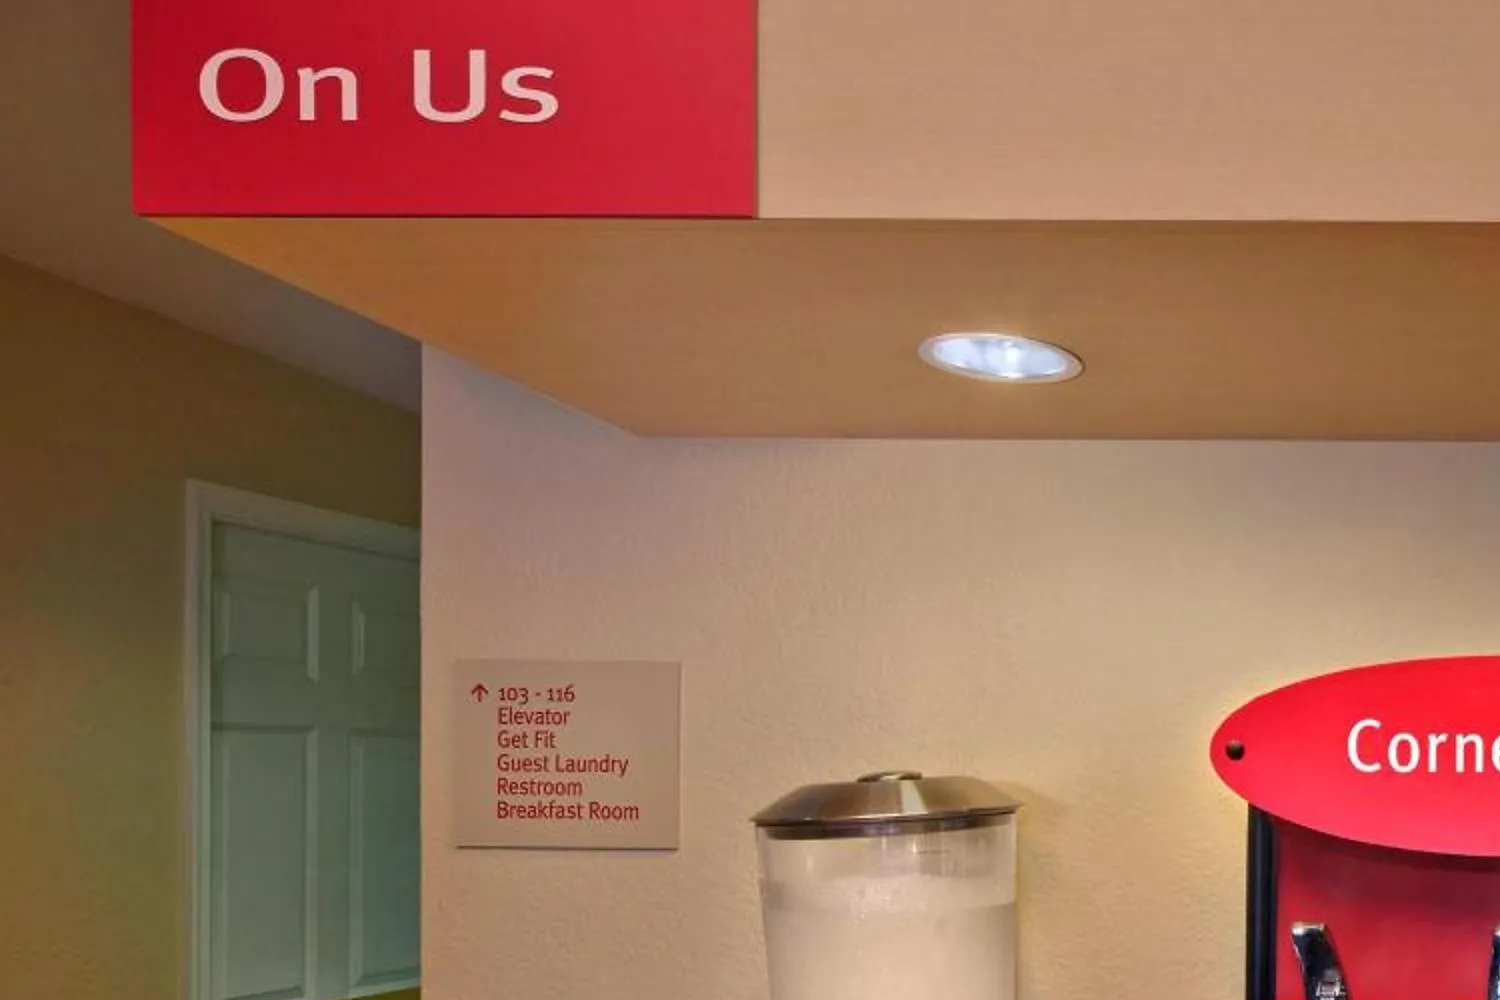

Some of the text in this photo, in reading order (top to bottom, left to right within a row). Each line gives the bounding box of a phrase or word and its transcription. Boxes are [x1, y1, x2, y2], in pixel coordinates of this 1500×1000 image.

[199, 48, 559, 123] On Us
[498, 687, 529, 705] 103
[547, 684, 575, 702] 116
[498, 707, 570, 726] Elevator
[497, 730, 557, 749] Get Fit
[497, 754, 629, 777] Guest Laundry
[497, 778, 583, 796] Restroom
[497, 801, 640, 820] Breakfast Room
